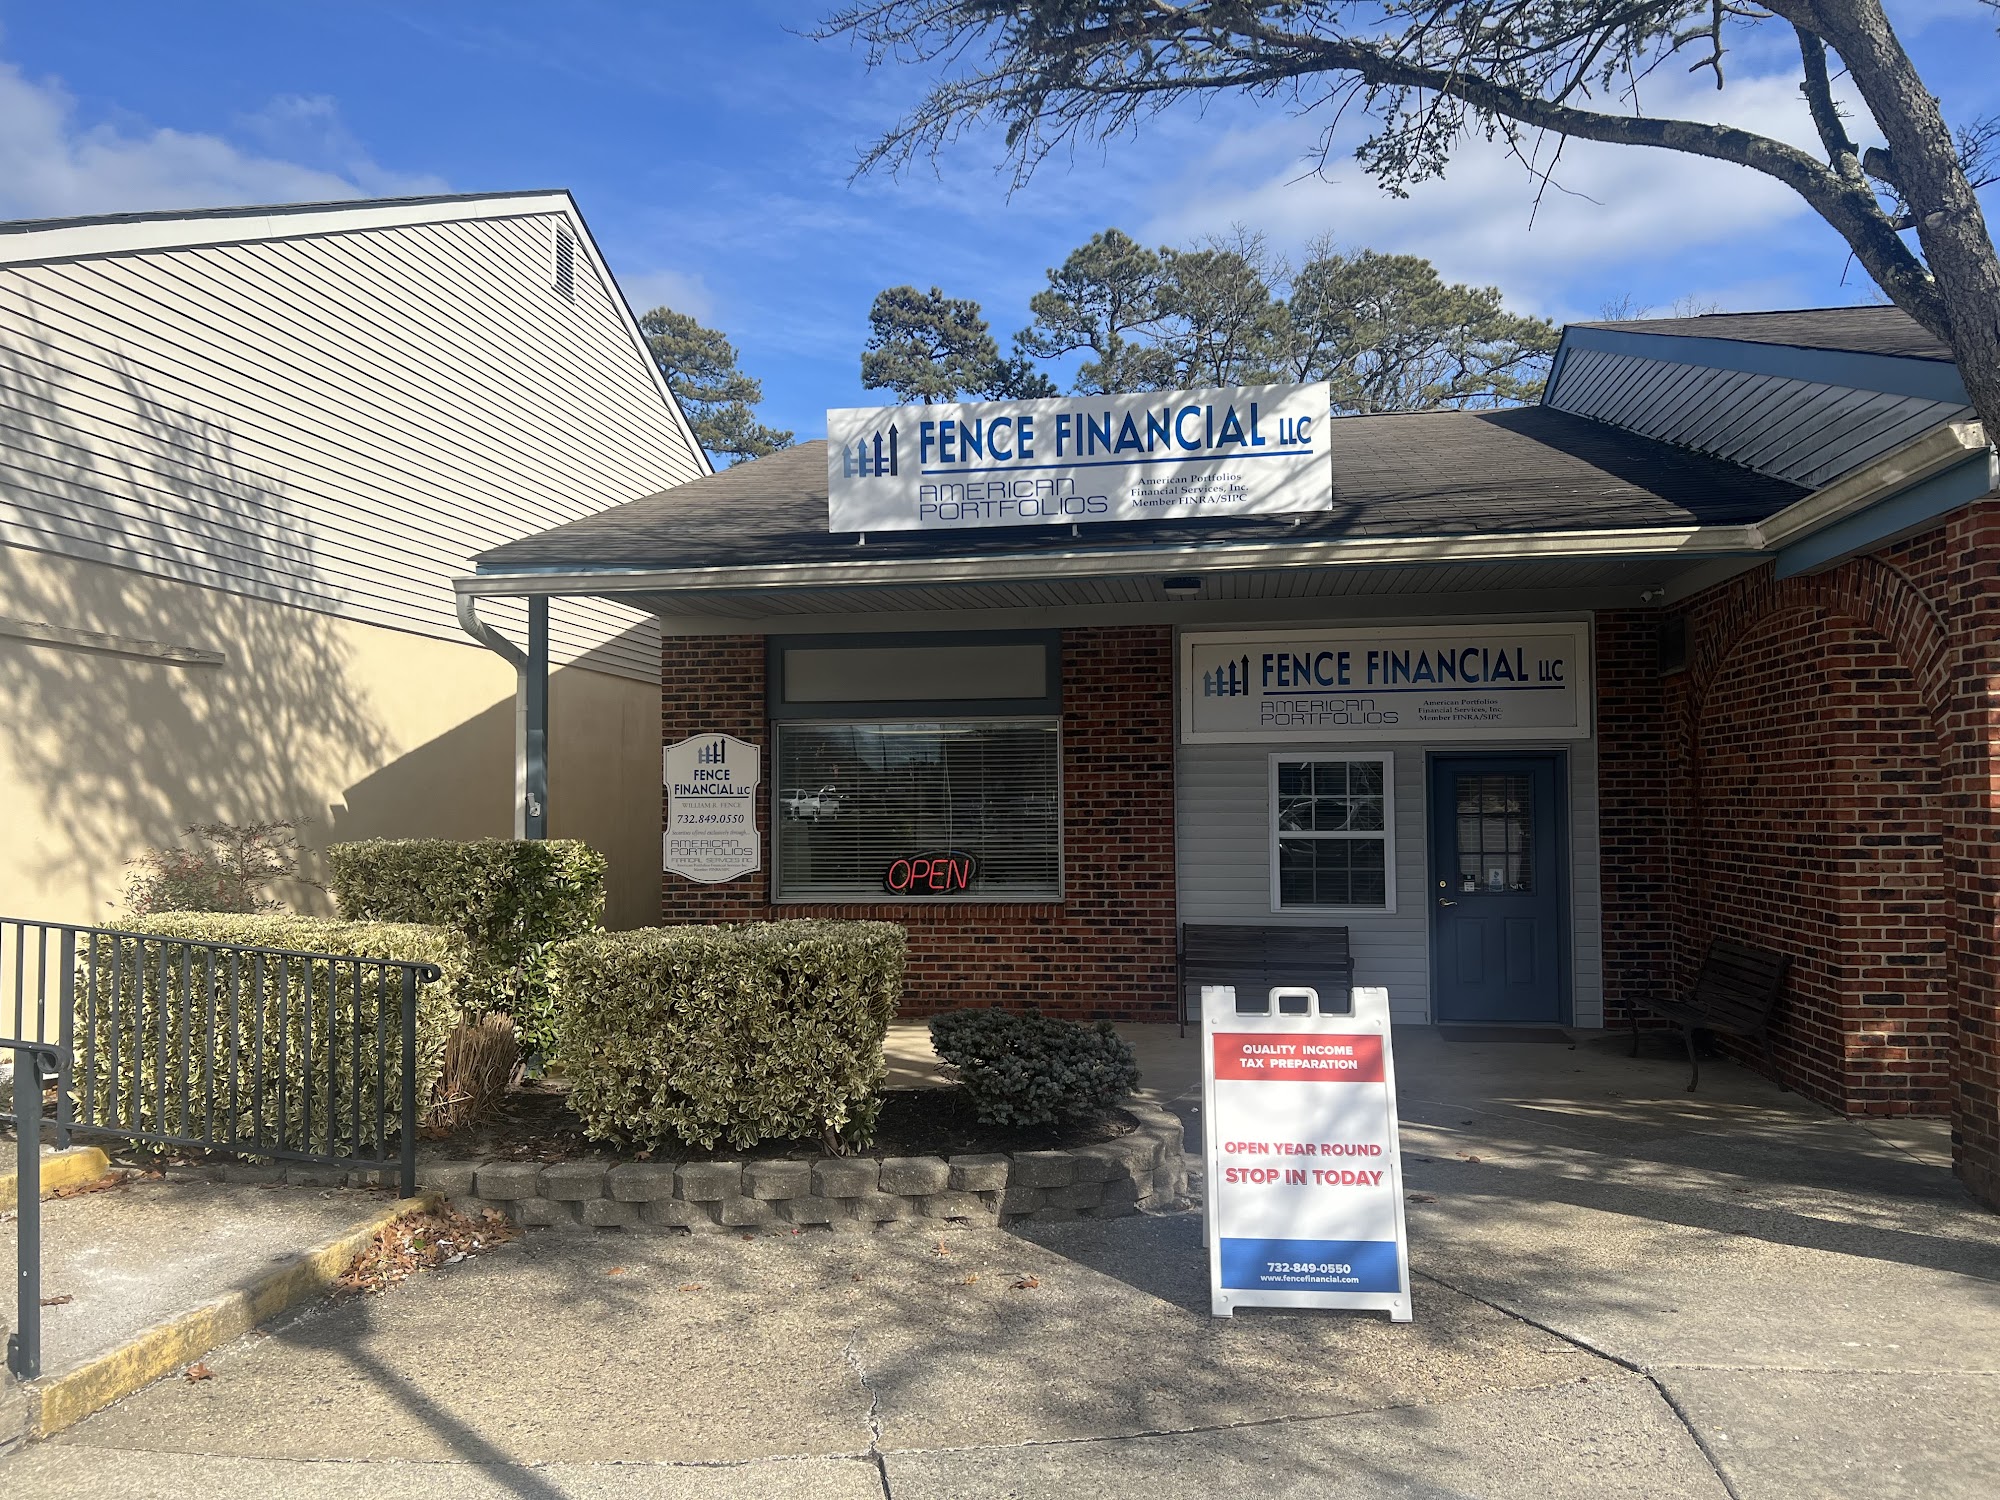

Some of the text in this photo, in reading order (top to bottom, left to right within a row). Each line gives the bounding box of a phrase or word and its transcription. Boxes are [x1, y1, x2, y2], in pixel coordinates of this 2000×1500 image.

[920, 402, 1312, 464] FENCE FINANCIAL LLC
[1138, 473, 1242, 486] American Portfolios
[920, 477, 1076, 503] AMERICAN
[1131, 483, 1249, 496] Financial Services, Inc.
[1132, 493, 1248, 507] Member FINRA/SIPC
[920, 495, 1108, 522] PORTFOLIOS
[1261, 647, 1564, 687] FENCE FINANCIAL LLC
[1261, 699, 1375, 713] AMERICAN
[1261, 711, 1399, 726] PORTFOLIOS
[694, 770, 730, 780] FENCE
[674, 784, 750, 795] FINANCIAL LLC
[677, 814, 745, 824] 732.849.0550
[670, 848, 753, 856] PORTFOLIOS
[888, 859, 969, 889] OPEN
[1242, 1044, 1353, 1056] QUALITY INCOME
[1240, 1058, 1358, 1070] TAX PREPARATION
[1225, 1141, 1382, 1157] OPEN YEAR ROUND
[1225, 1168, 1384, 1187] STOP IN TODAY
[1267, 1262, 1351, 1274] 732-849-0550
[1260, 1274, 1359, 1284] www.fencefinancial.com
